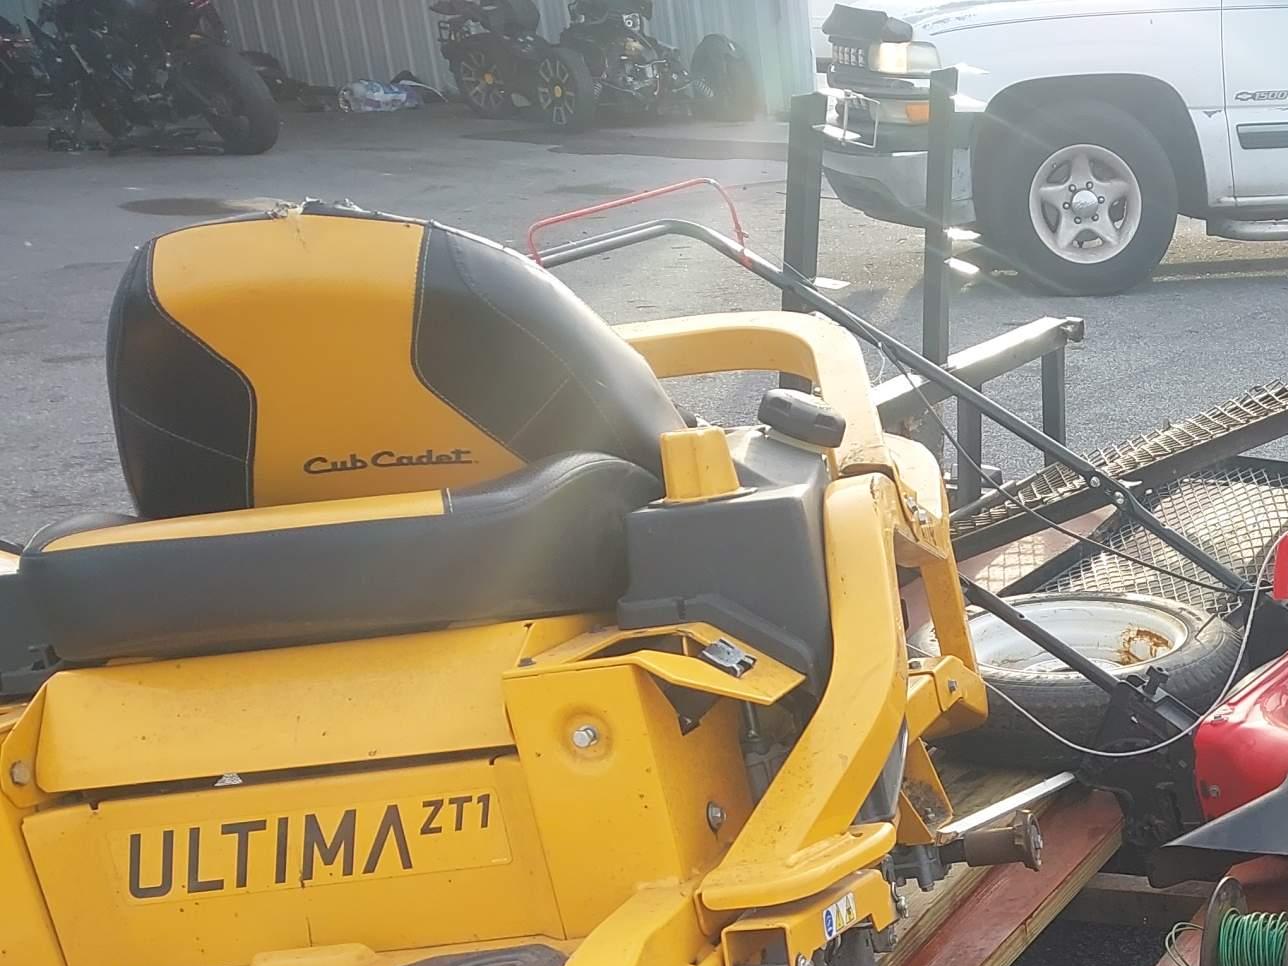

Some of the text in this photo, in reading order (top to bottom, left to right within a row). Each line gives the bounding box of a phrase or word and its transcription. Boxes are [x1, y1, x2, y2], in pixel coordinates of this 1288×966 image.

[1255, 91, 1288, 101] 1500
[303, 448, 473, 474] Cub Cadet
[128, 793, 491, 899] ULTIMA ZT1
